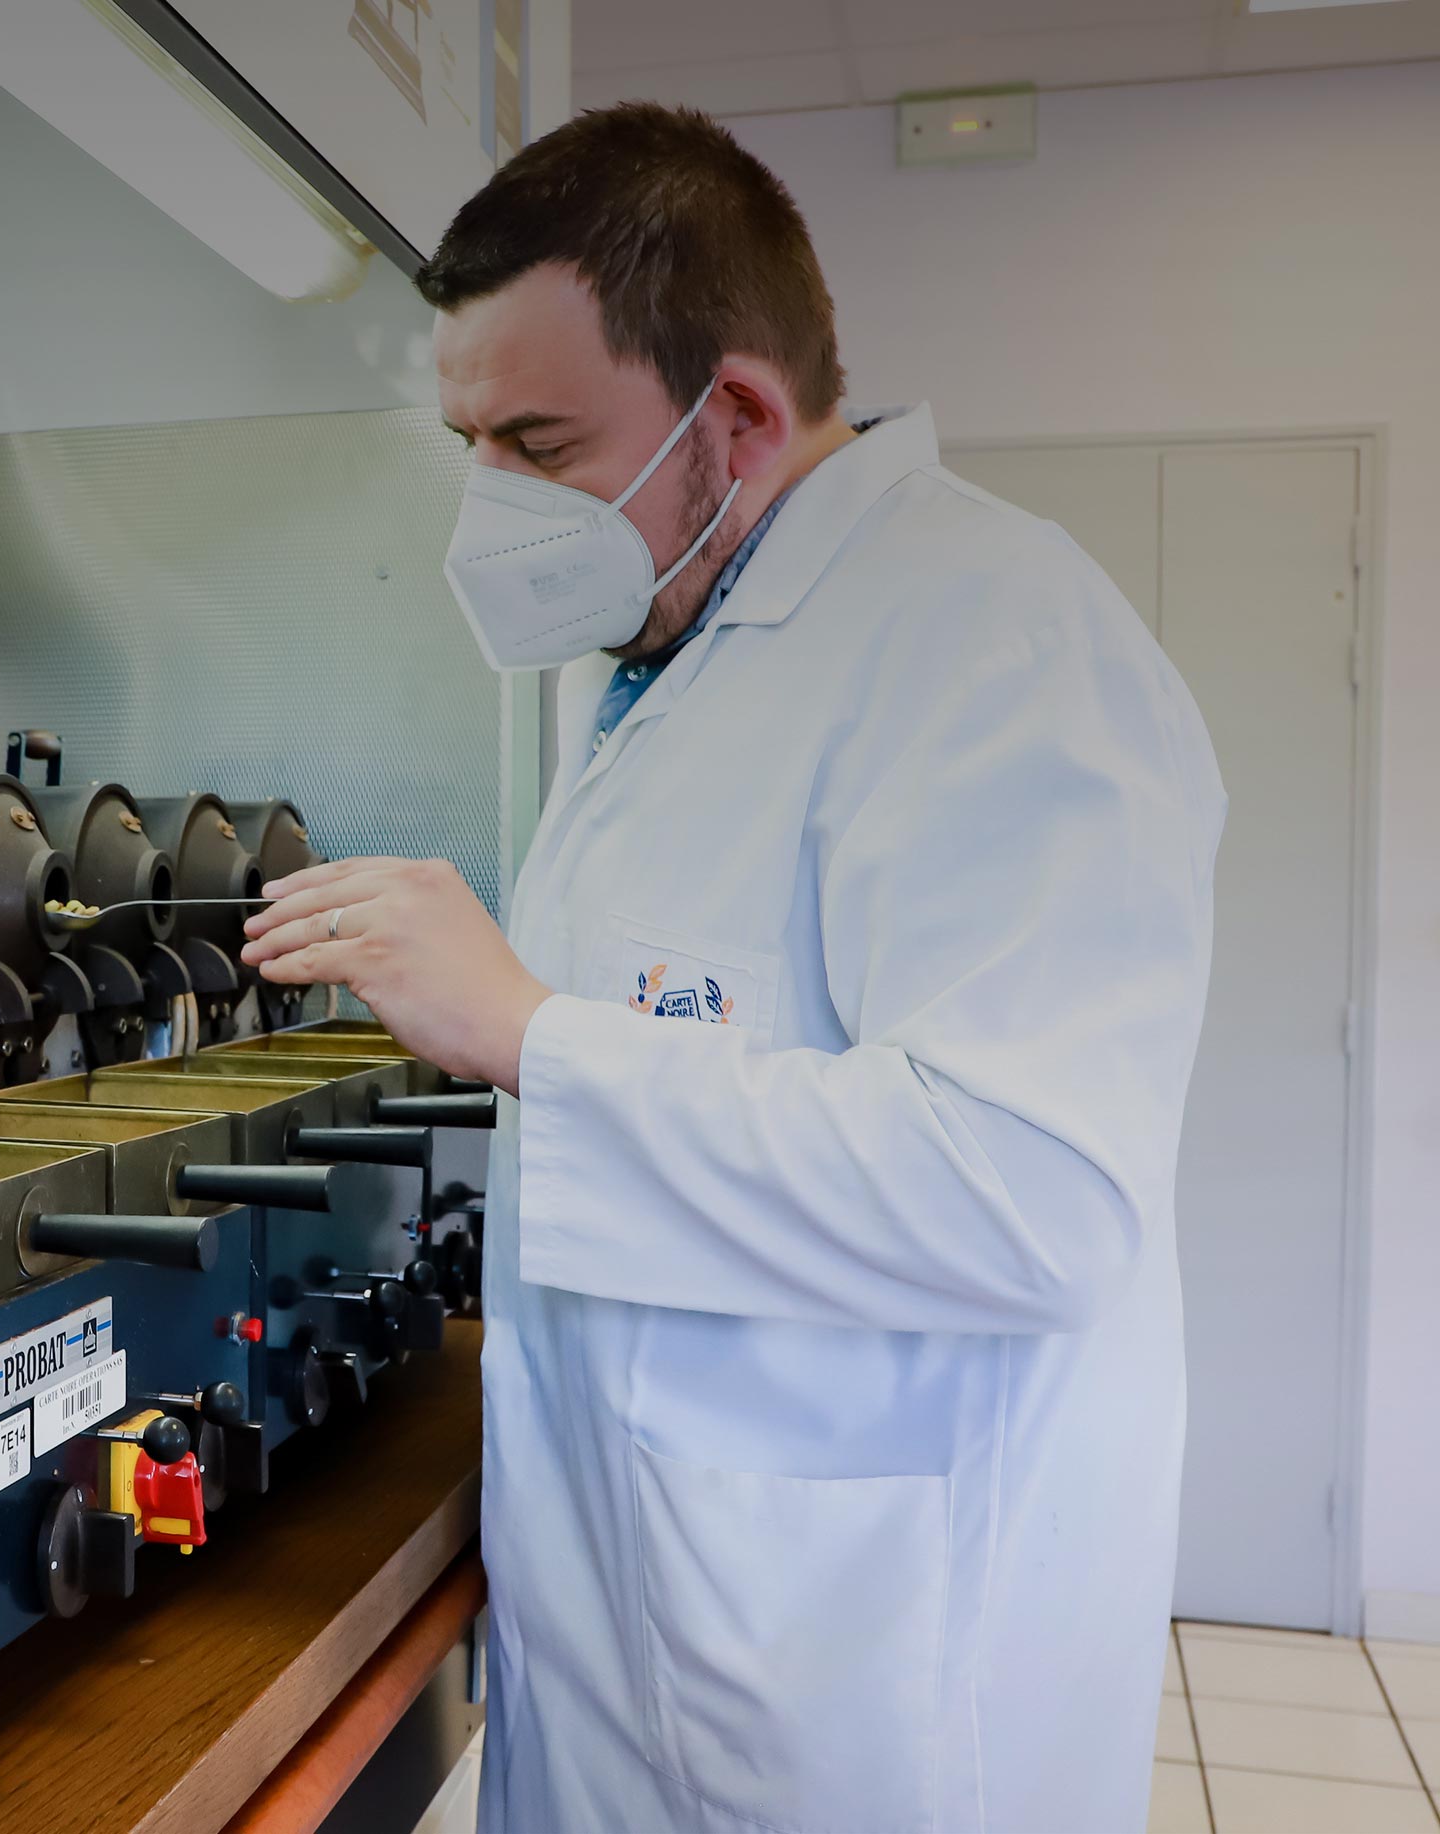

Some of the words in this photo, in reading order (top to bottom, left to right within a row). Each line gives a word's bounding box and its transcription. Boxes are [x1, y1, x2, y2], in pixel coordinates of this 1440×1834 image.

[665, 996, 693, 1009] CARTE
[666, 1006, 695, 1017] NOIRE
[3, 1331, 68, 1398] PROBAT
[39, 1390, 59, 1408] CARTE
[59, 1381, 77, 1396] NOIRE
[0, 1424, 27, 1455] 7E14
